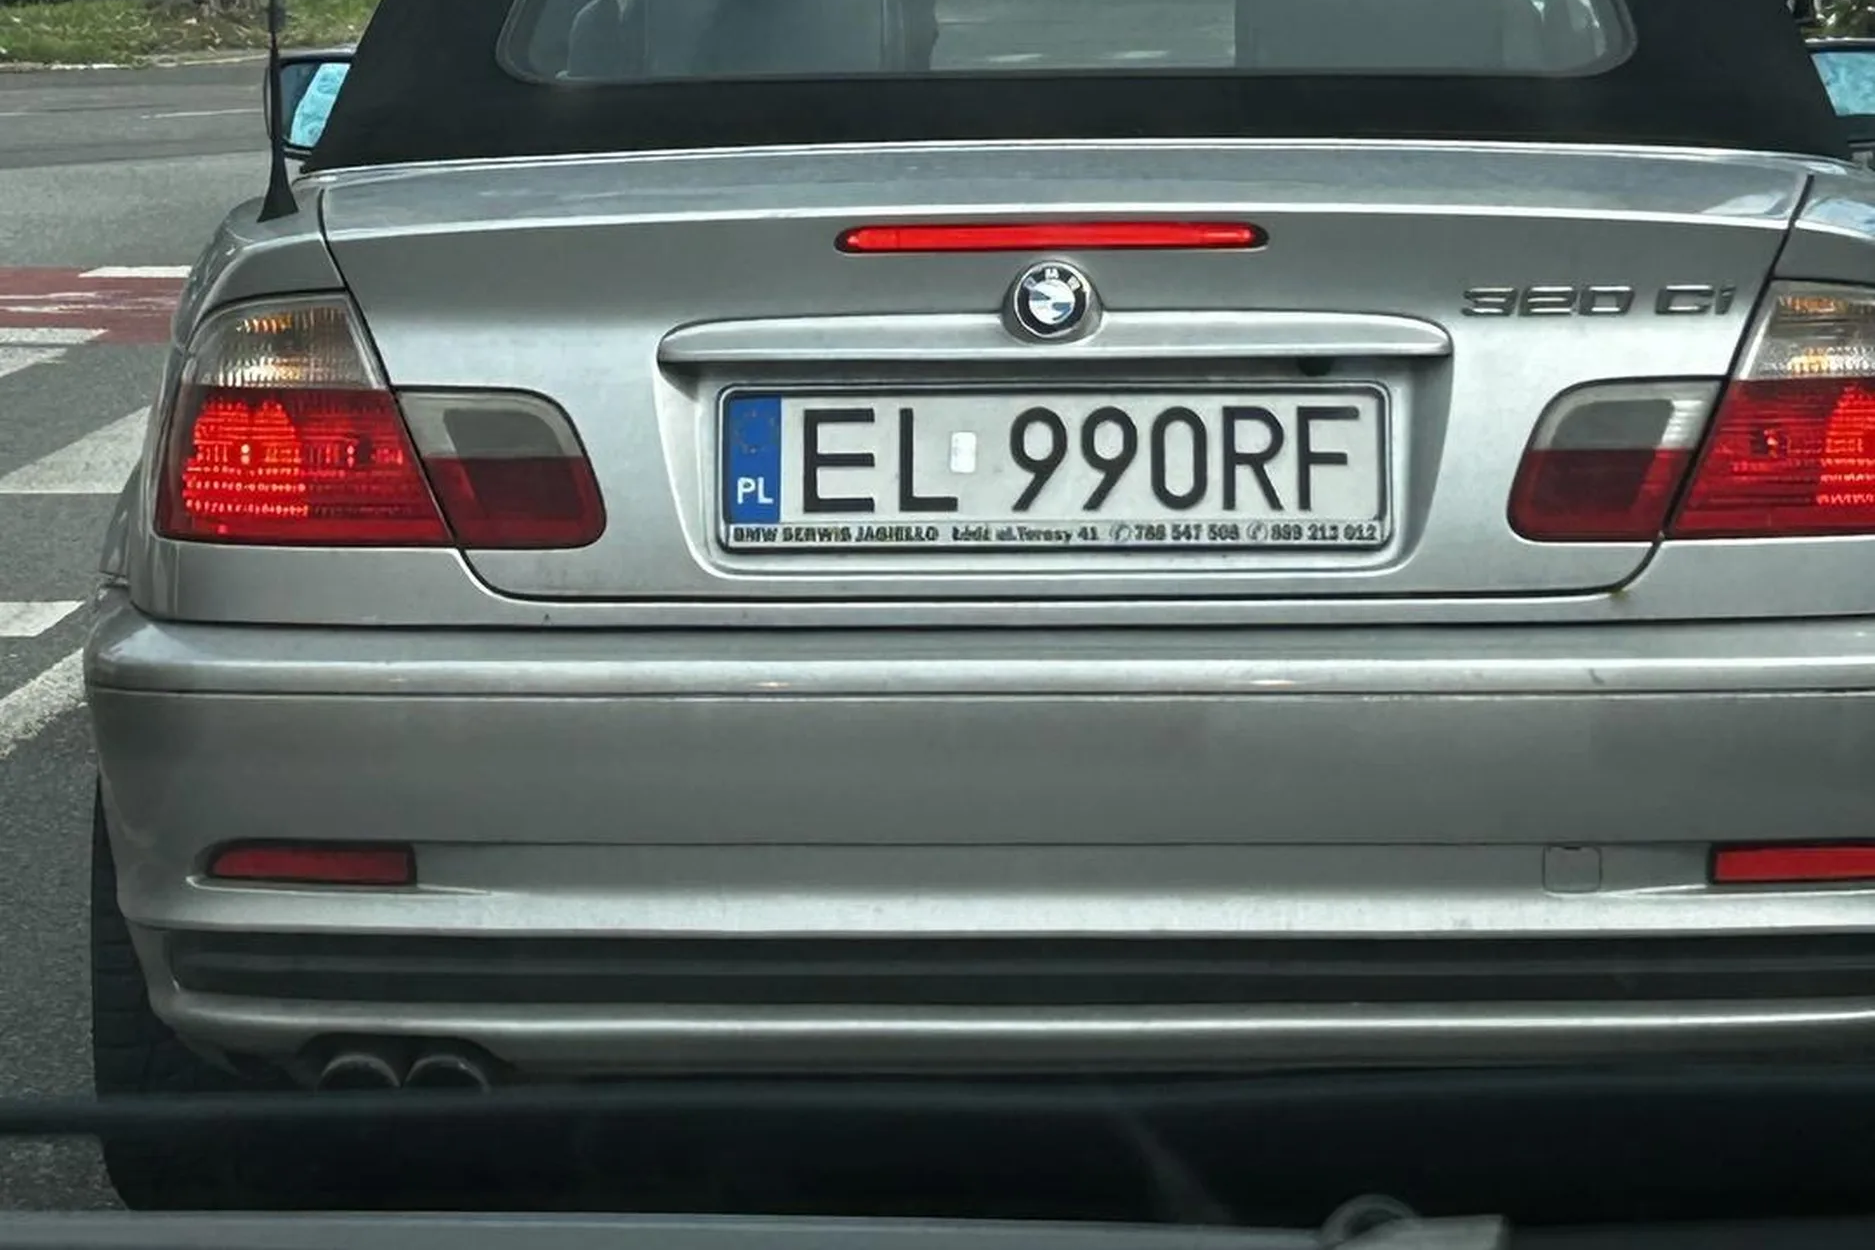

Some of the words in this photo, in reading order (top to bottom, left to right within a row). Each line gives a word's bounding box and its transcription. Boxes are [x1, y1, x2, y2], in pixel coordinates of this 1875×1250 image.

[1461, 285, 1635, 316] 320
[1655, 285, 1736, 315] Ci
[803, 407, 958, 513] EL
[1010, 405, 1360, 512] 990RF
[737, 476, 774, 504] PL
[733, 527, 777, 542] BMW
[1078, 526, 1098, 541] 41
